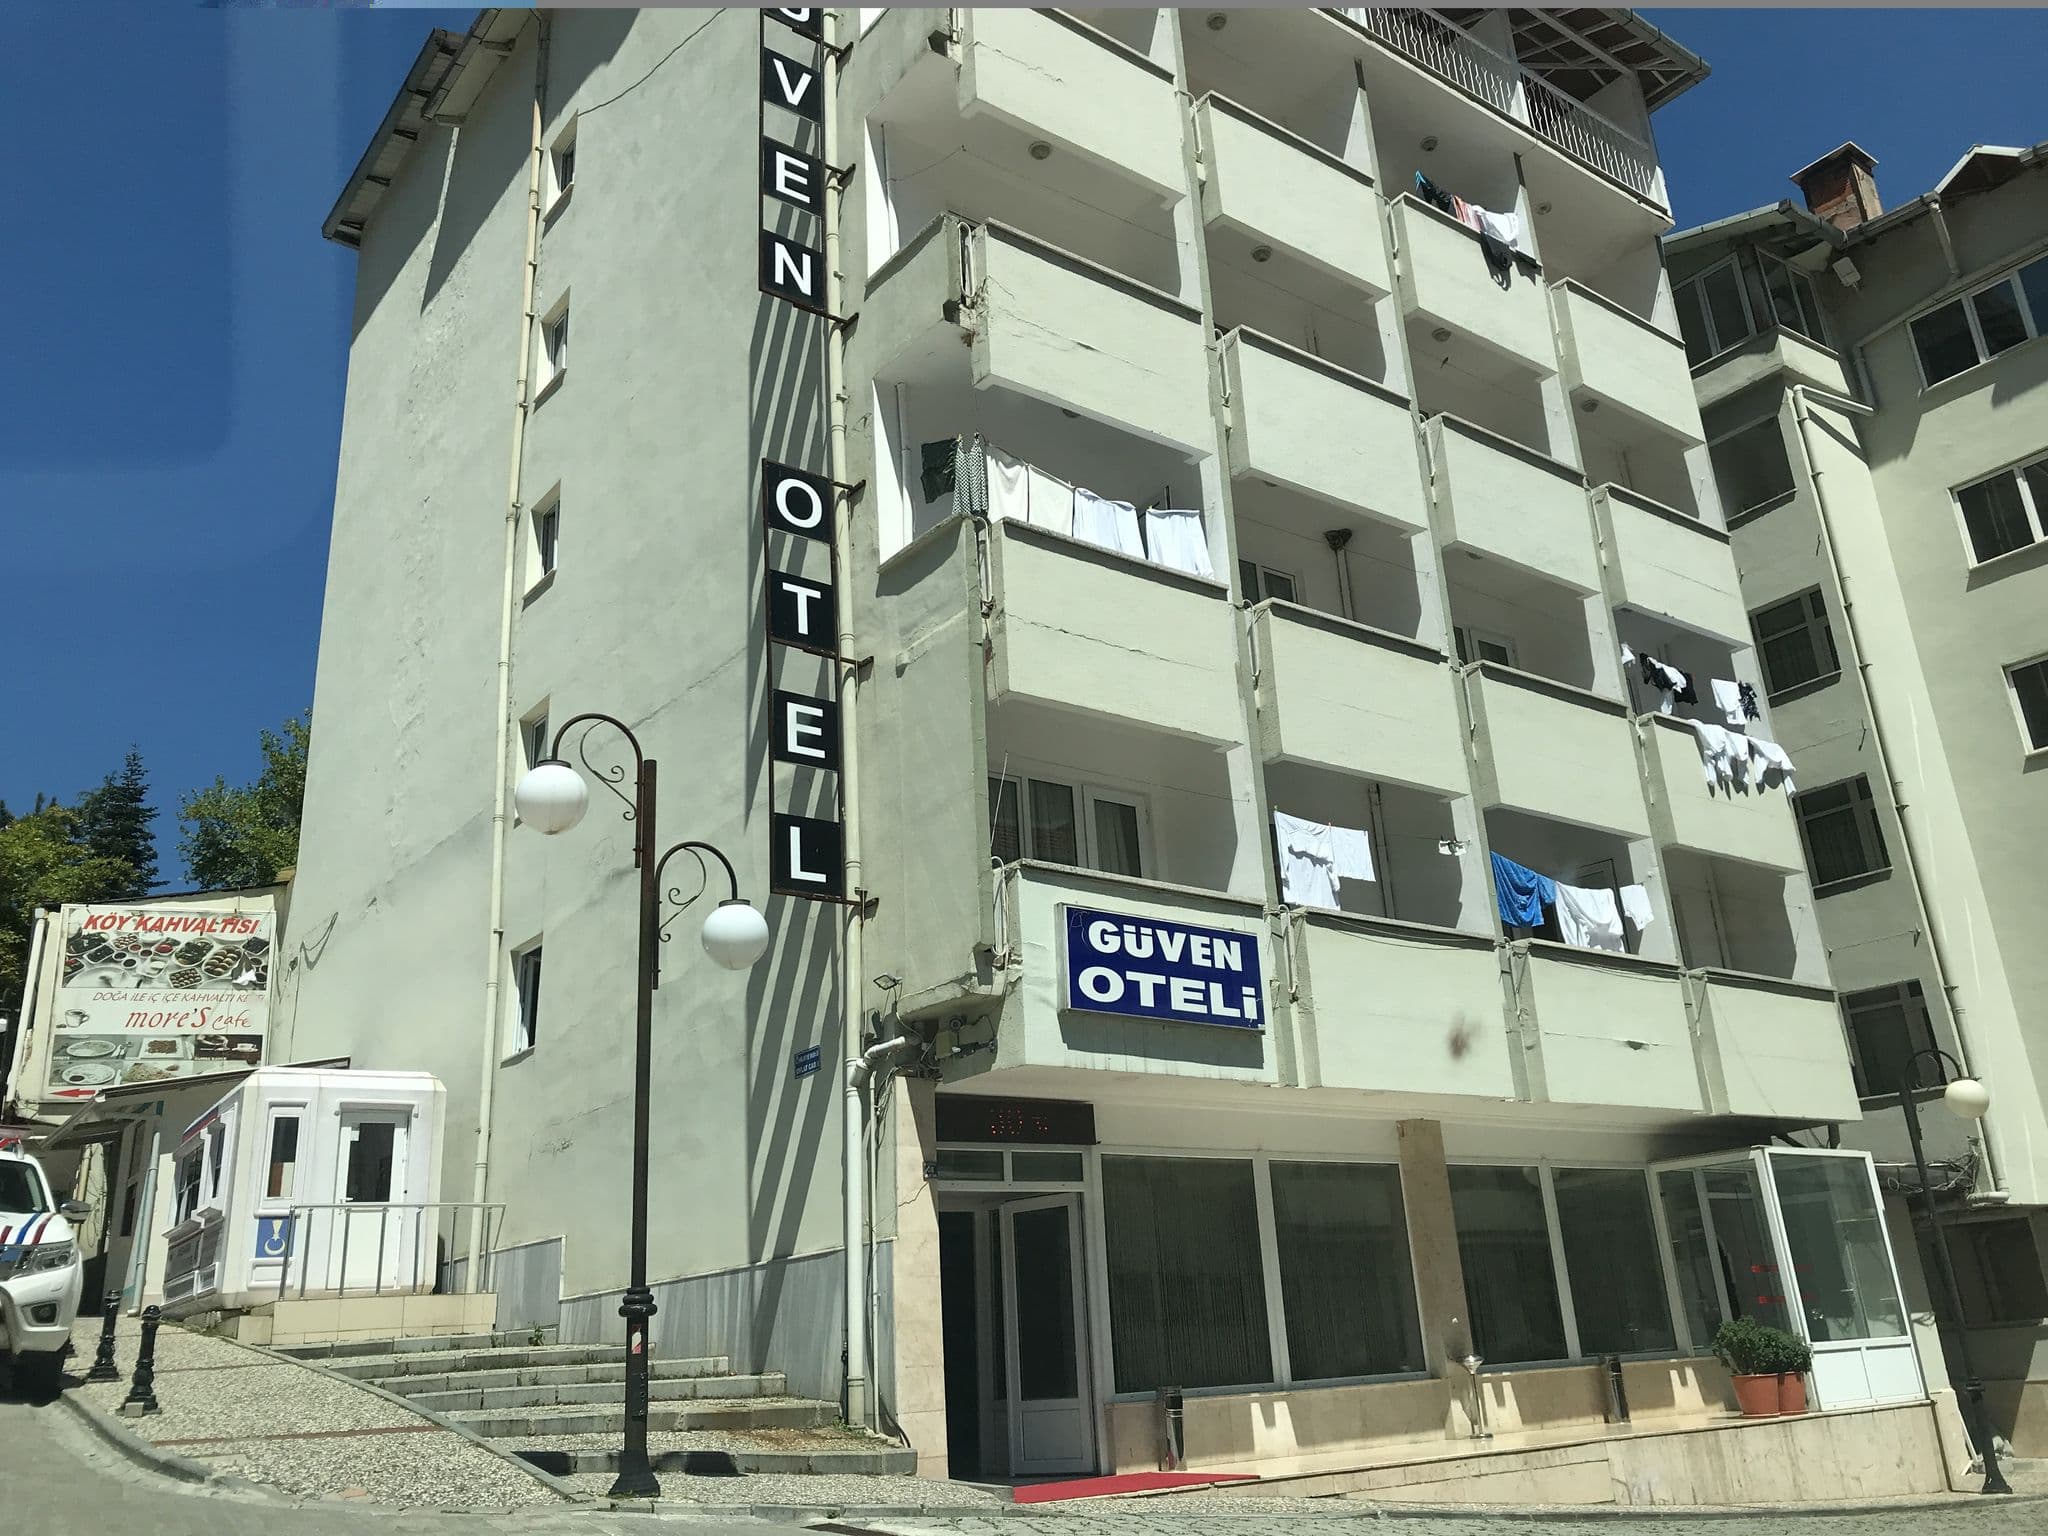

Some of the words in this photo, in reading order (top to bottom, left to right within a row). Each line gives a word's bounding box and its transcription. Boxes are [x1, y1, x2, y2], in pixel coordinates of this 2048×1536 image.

[775, 477, 827, 884] OTEL
[82, 912, 134, 931] KÖY
[134, 914, 261, 935] KAHVALTISI
[1088, 920, 1243, 972] GÜVEN
[93, 991, 128, 1001] DOĞA
[182, 993, 235, 1003] KAHVALTI
[212, 1009, 251, 1031] cafe
